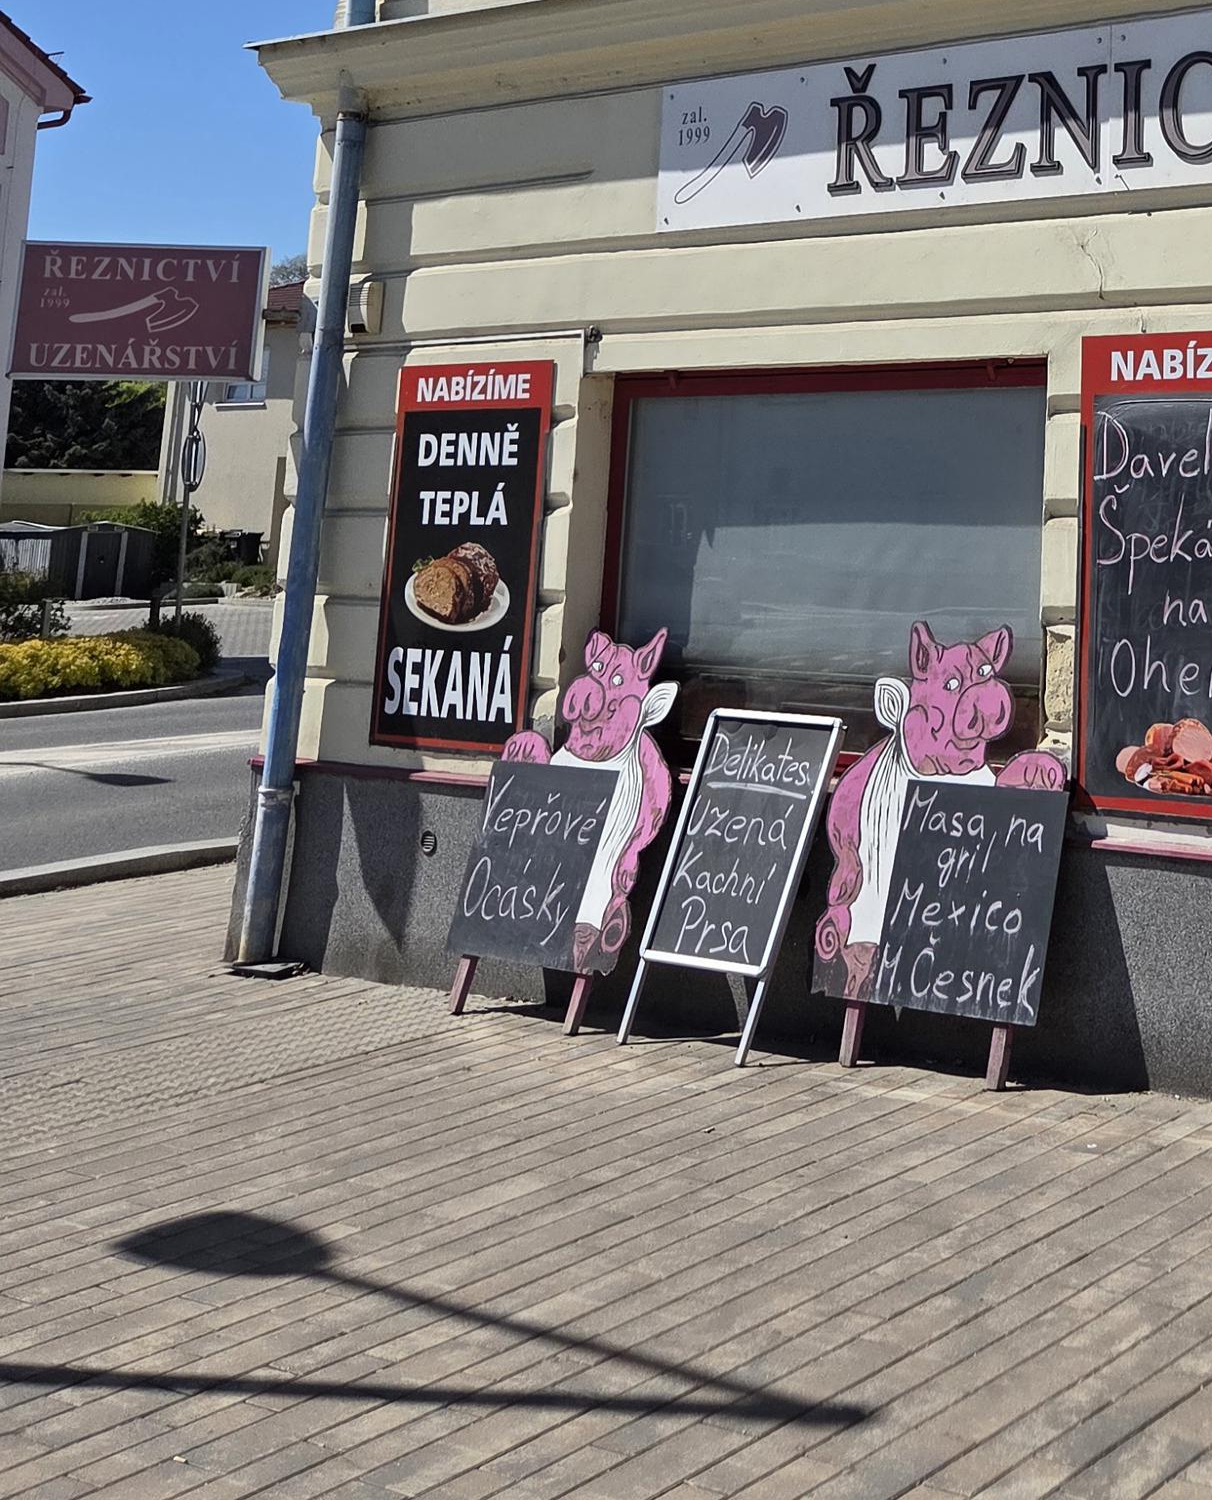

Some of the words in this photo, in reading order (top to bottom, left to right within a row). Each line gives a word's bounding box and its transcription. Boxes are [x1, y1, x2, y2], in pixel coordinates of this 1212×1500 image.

[678, 125, 711, 147] 1999
[681, 106, 709, 125] zal.
[43, 249, 241, 283] ŘEZNICTVÍ
[40, 297, 71, 309] 1999
[29, 338, 239, 370] UZENÁŘSTVÍ
[416, 369, 531, 403] NABÍZÍME
[417, 423, 520, 467] DENNĚ
[419, 482, 508, 526] TEPLÁ
[1163, 589, 1208, 627] na
[384, 635, 514, 724] SEKANÁ
[482, 774, 607, 848] Vepřové
[687, 795, 794, 851] Uzená
[903, 785, 985, 840] Masa
[1005, 814, 1045, 853] na
[673, 840, 777, 905] Kachní
[937, 831, 997, 889] gril
[463, 856, 570, 946] Ocásky
[890, 877, 1023, 936] Mexico
[675, 896, 750, 963] Prsa
[910, 932, 1041, 1017] Česnek
